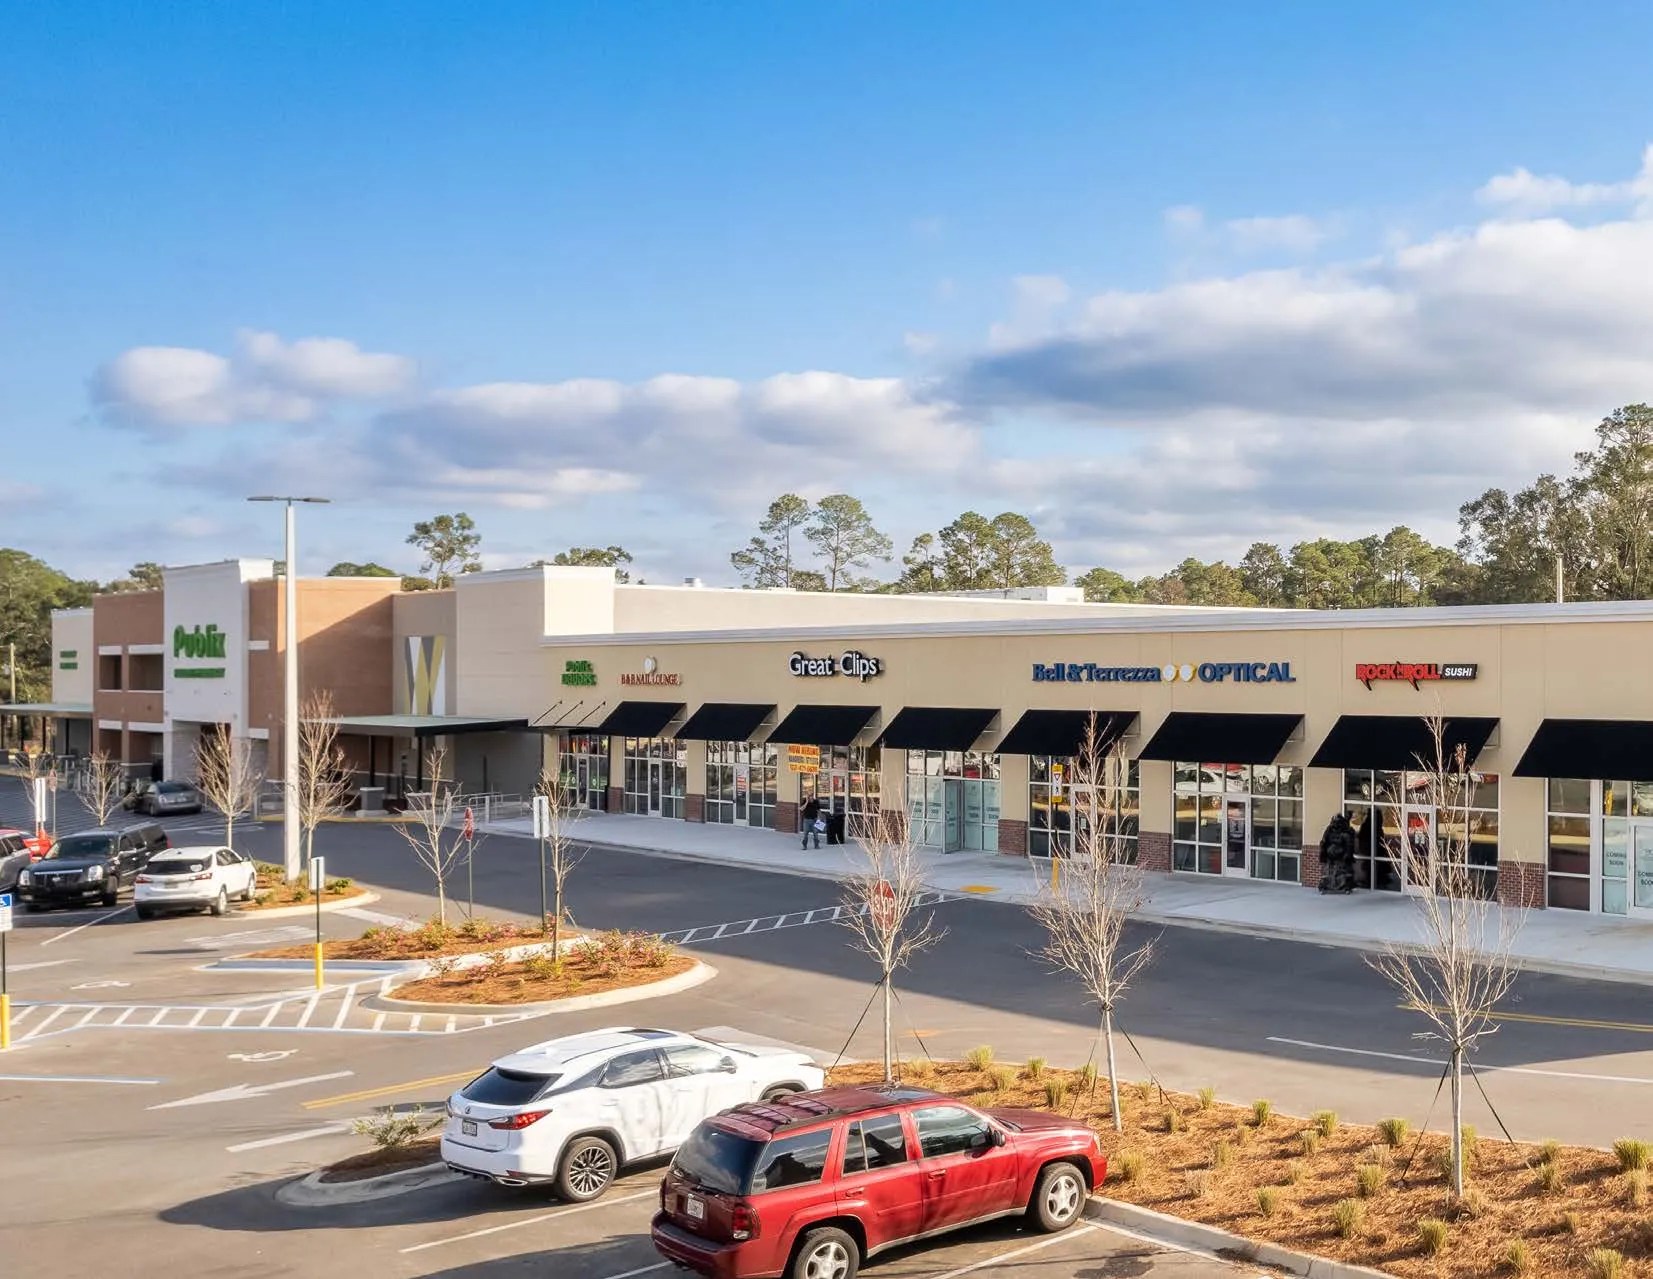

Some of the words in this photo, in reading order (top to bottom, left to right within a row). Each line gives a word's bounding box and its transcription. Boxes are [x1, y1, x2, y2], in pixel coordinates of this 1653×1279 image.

[788, 651, 834, 676] Great
[840, 650, 880, 682] Clips
[1032, 662, 1065, 681] Bell
[1066, 663, 1083, 682] &
[1198, 662, 1296, 682] OPTICAL
[1444, 667, 1473, 677] SUSHI
